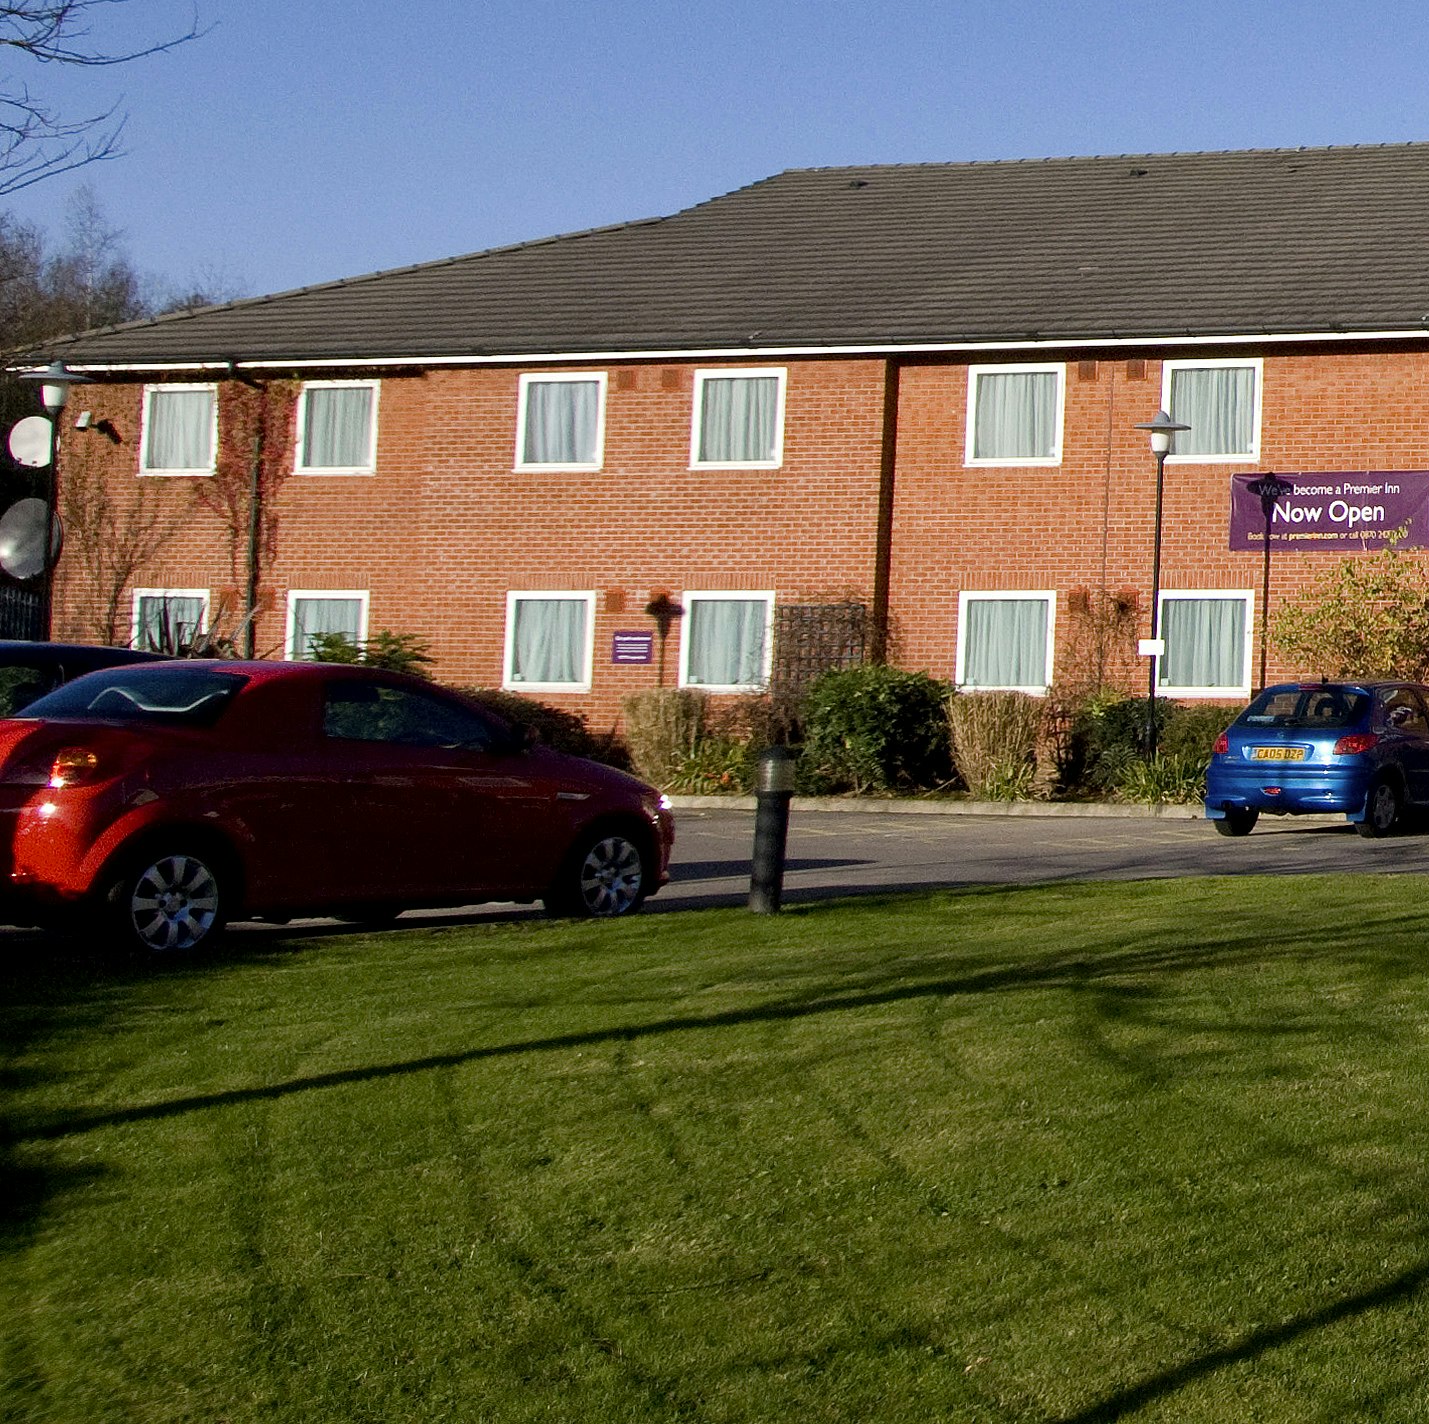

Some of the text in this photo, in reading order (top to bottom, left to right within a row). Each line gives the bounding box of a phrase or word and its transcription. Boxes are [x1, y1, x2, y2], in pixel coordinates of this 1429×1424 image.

[1293, 484, 1333, 496] become
[1335, 487, 1341, 495] a
[1343, 483, 1383, 495] Premier
[1385, 482, 1400, 494] Inn
[1272, 500, 1385, 528] Now Open
